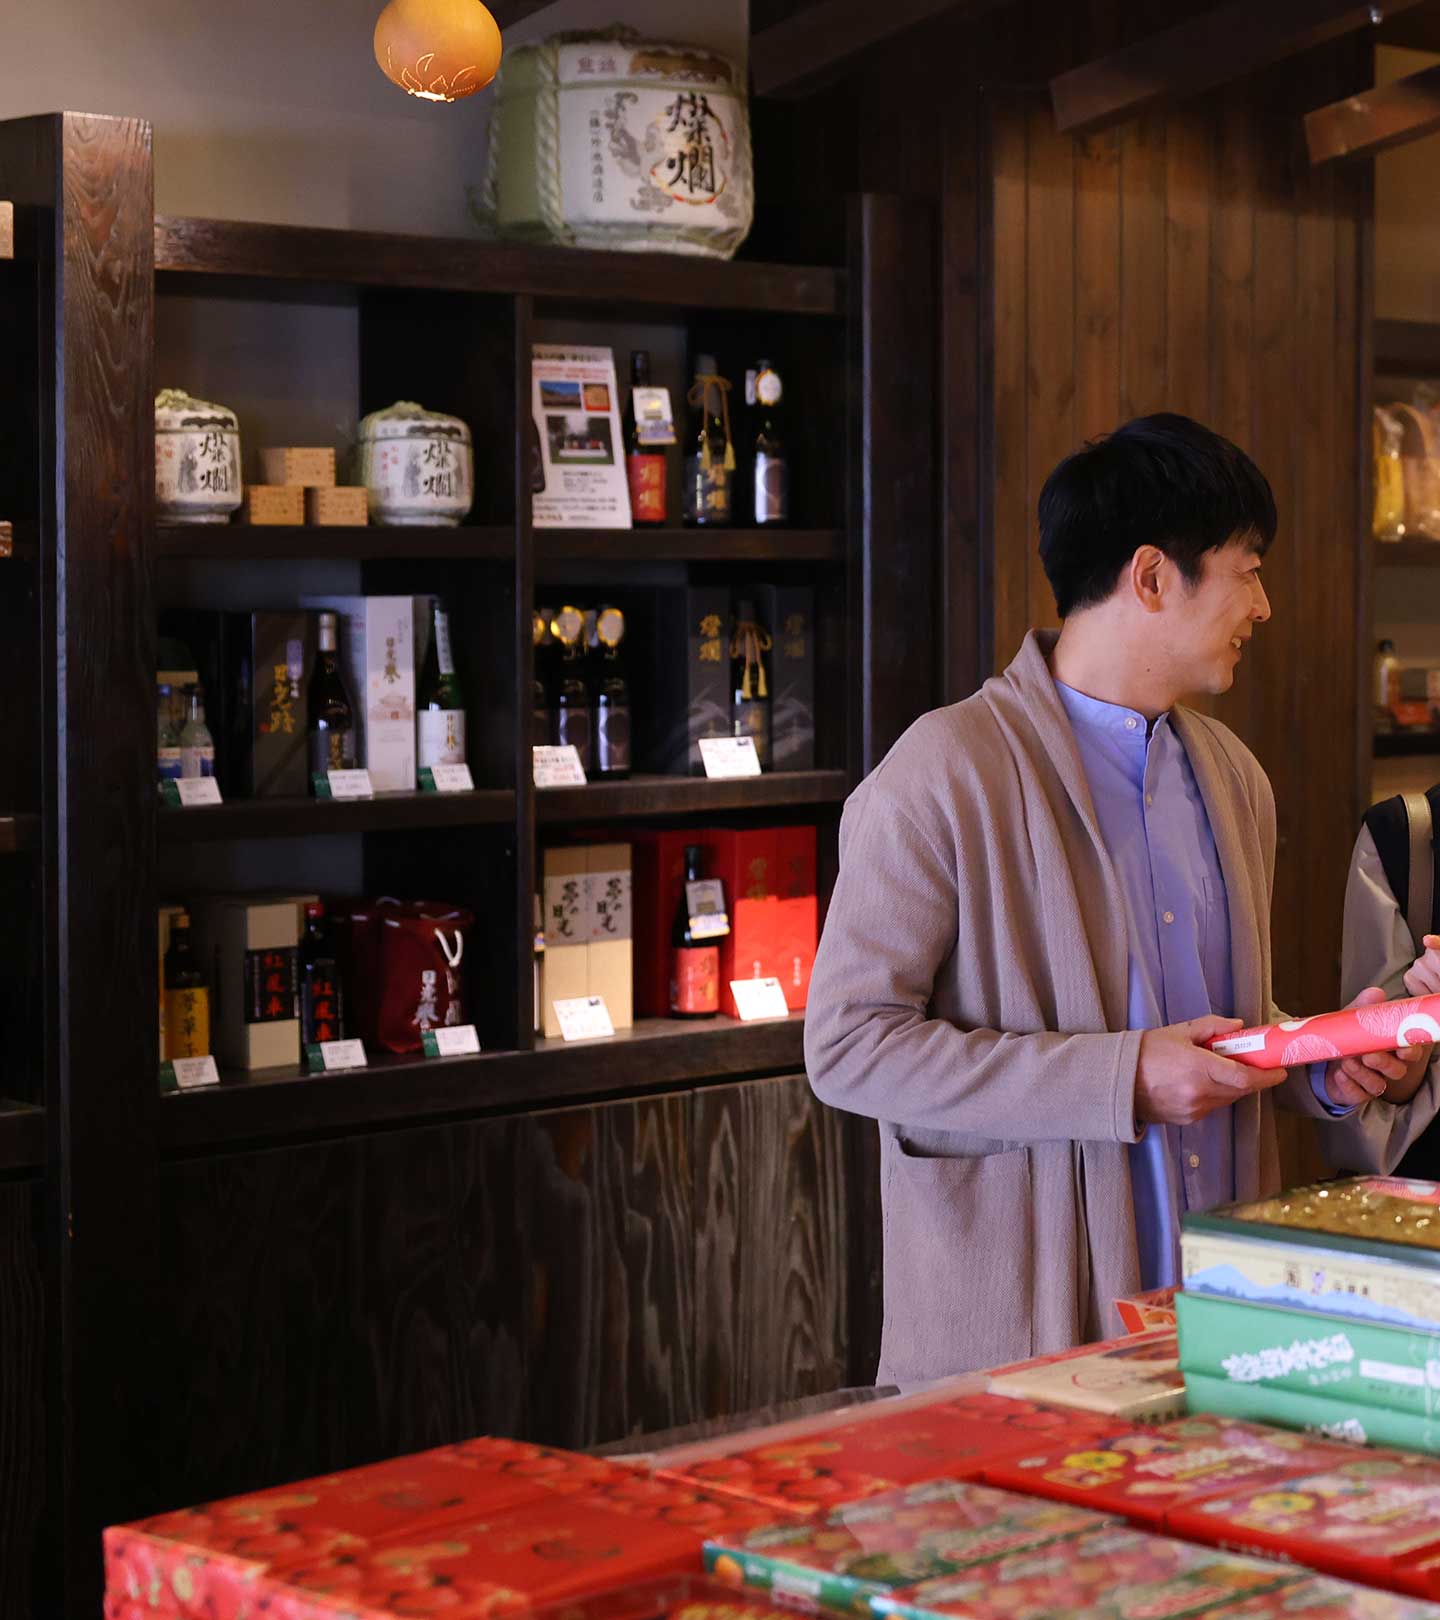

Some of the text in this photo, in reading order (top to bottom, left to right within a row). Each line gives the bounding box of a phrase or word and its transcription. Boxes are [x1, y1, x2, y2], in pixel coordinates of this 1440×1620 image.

[666, 91, 716, 194] 燦爛
[199, 431, 229, 494] 燦爛
[423, 439, 452, 499] 燦爛
